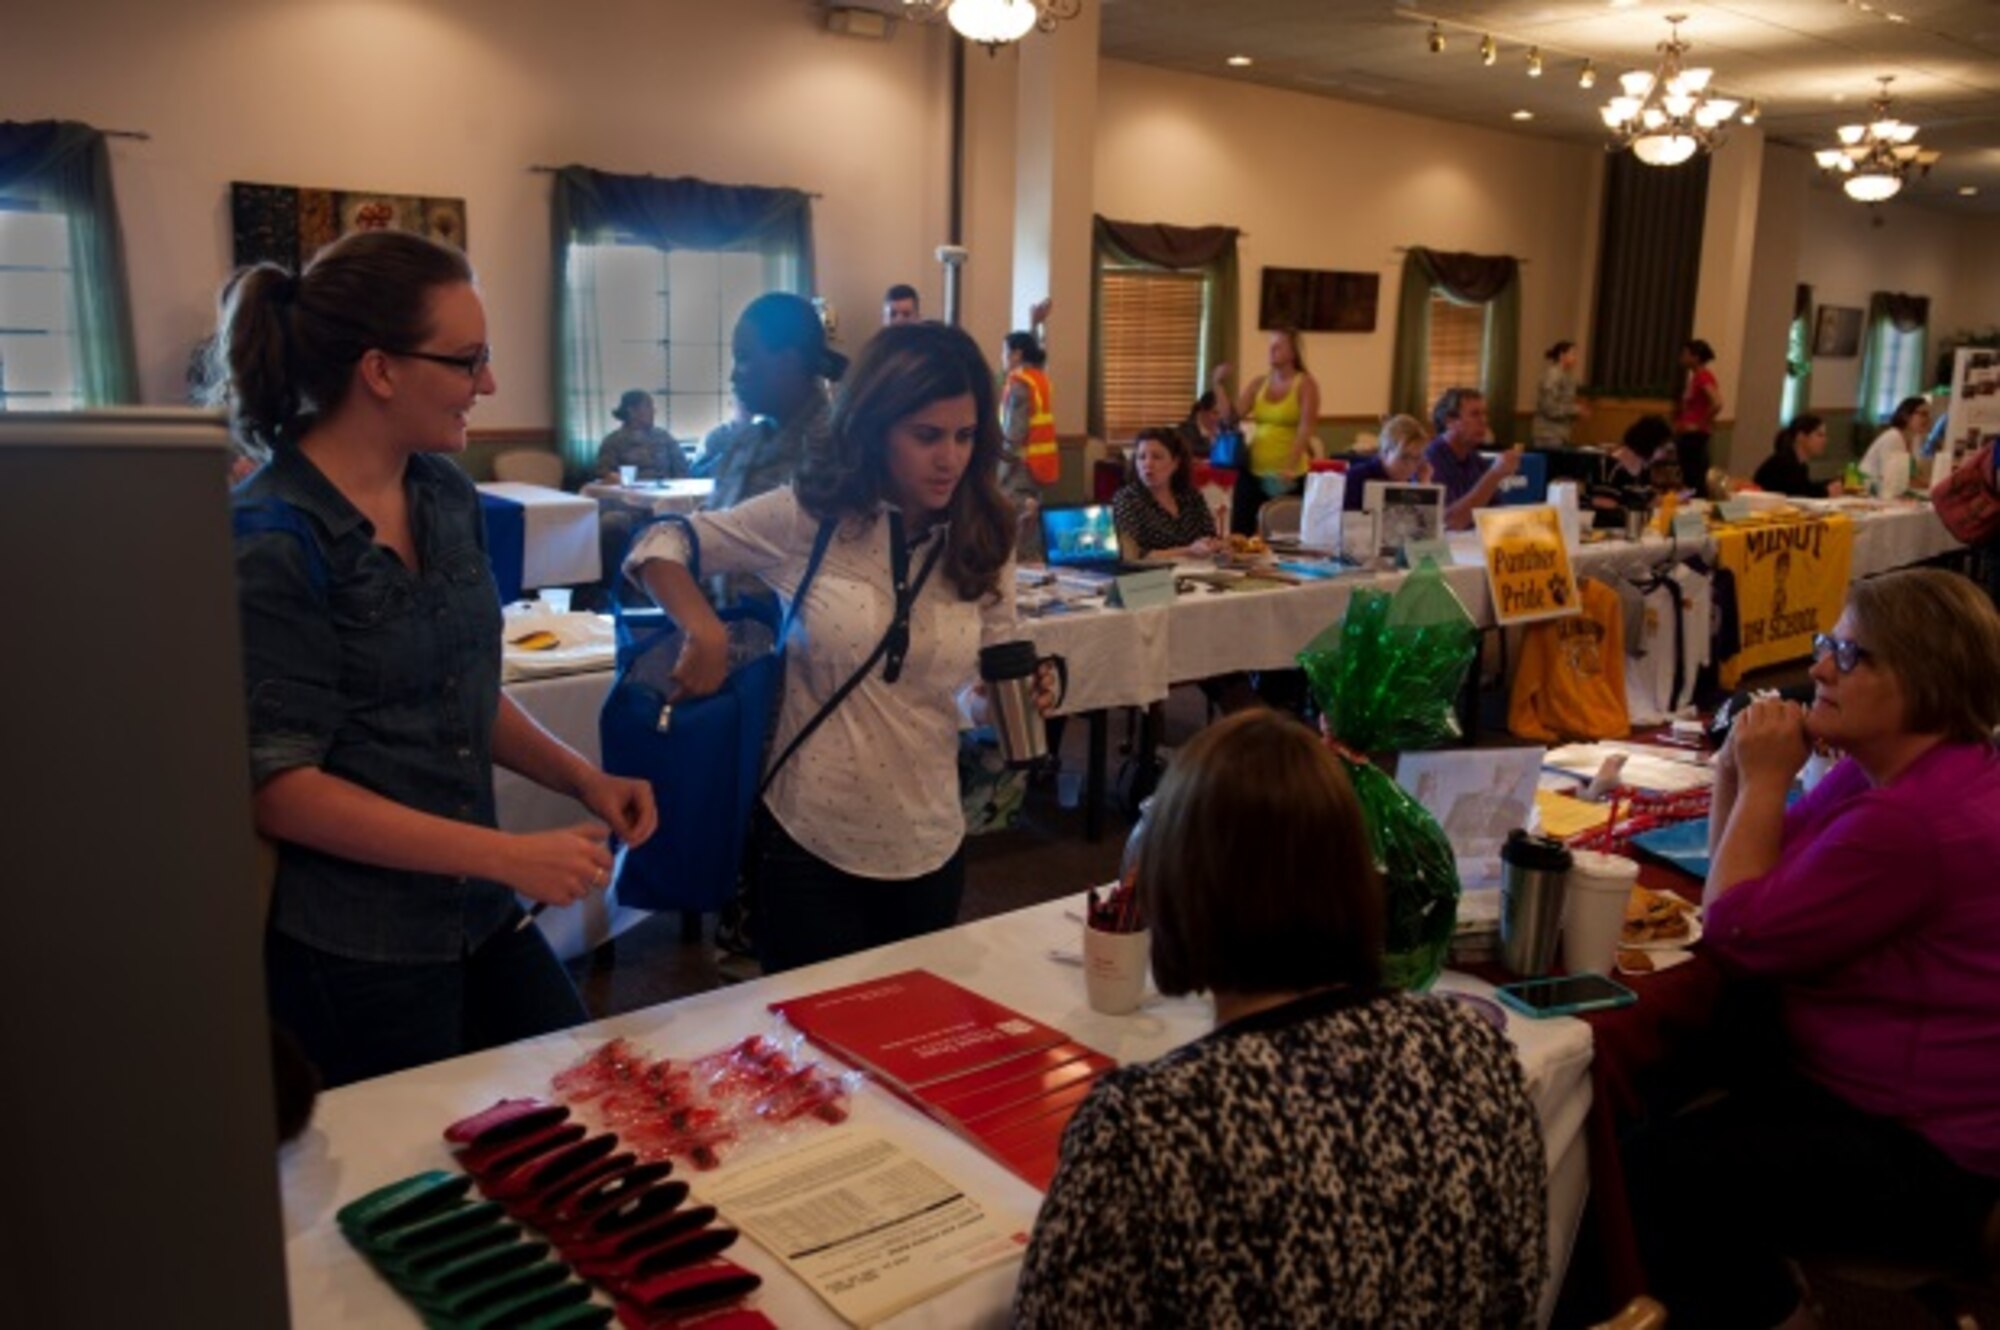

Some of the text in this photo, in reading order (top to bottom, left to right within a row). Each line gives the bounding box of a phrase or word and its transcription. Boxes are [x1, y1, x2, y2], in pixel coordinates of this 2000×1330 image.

[1494, 543, 1557, 576] Panther
[1502, 578, 1545, 612] Pride
[1768, 606, 1819, 642] SCHOOL
